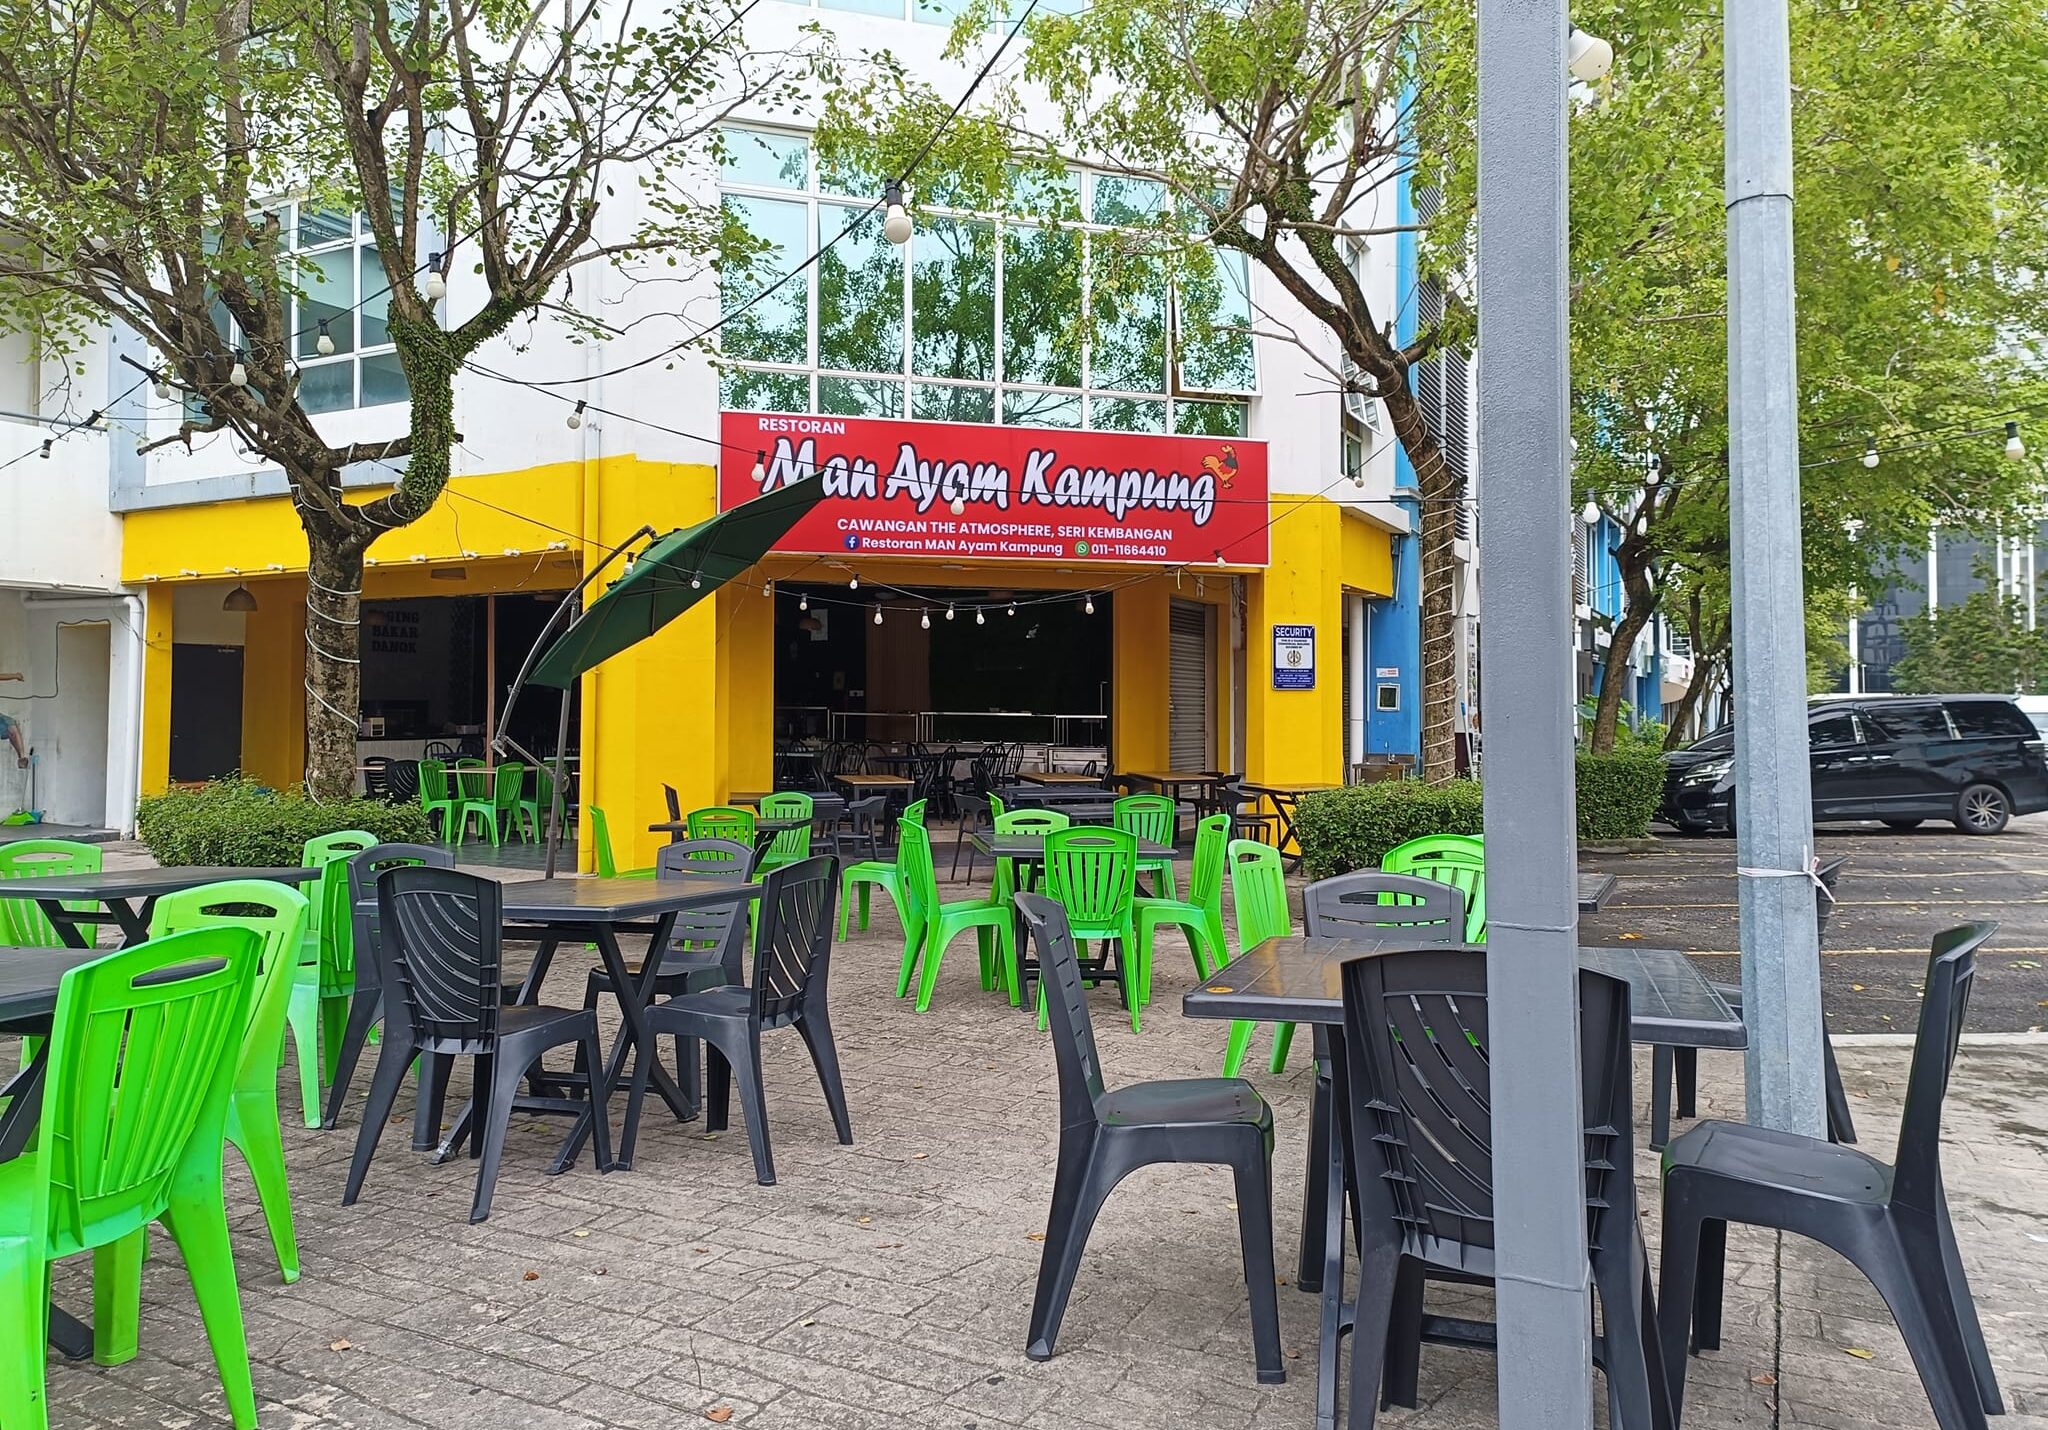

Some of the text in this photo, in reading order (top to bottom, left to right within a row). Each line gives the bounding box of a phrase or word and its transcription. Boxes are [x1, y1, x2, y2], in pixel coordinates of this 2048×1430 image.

[758, 417, 845, 435] RESTORAN
[760, 437, 1215, 526] Man Ayam Kampung
[837, 518, 1173, 540] CAWANGAN THE ATMOSPHERE, SERI KEMBANGAN
[862, 537, 1063, 556] Restoran MAN Ayam Kampung
[1091, 543, 1167, 556] 011-11664410
[1275, 626, 1313, 637] SECURITY
